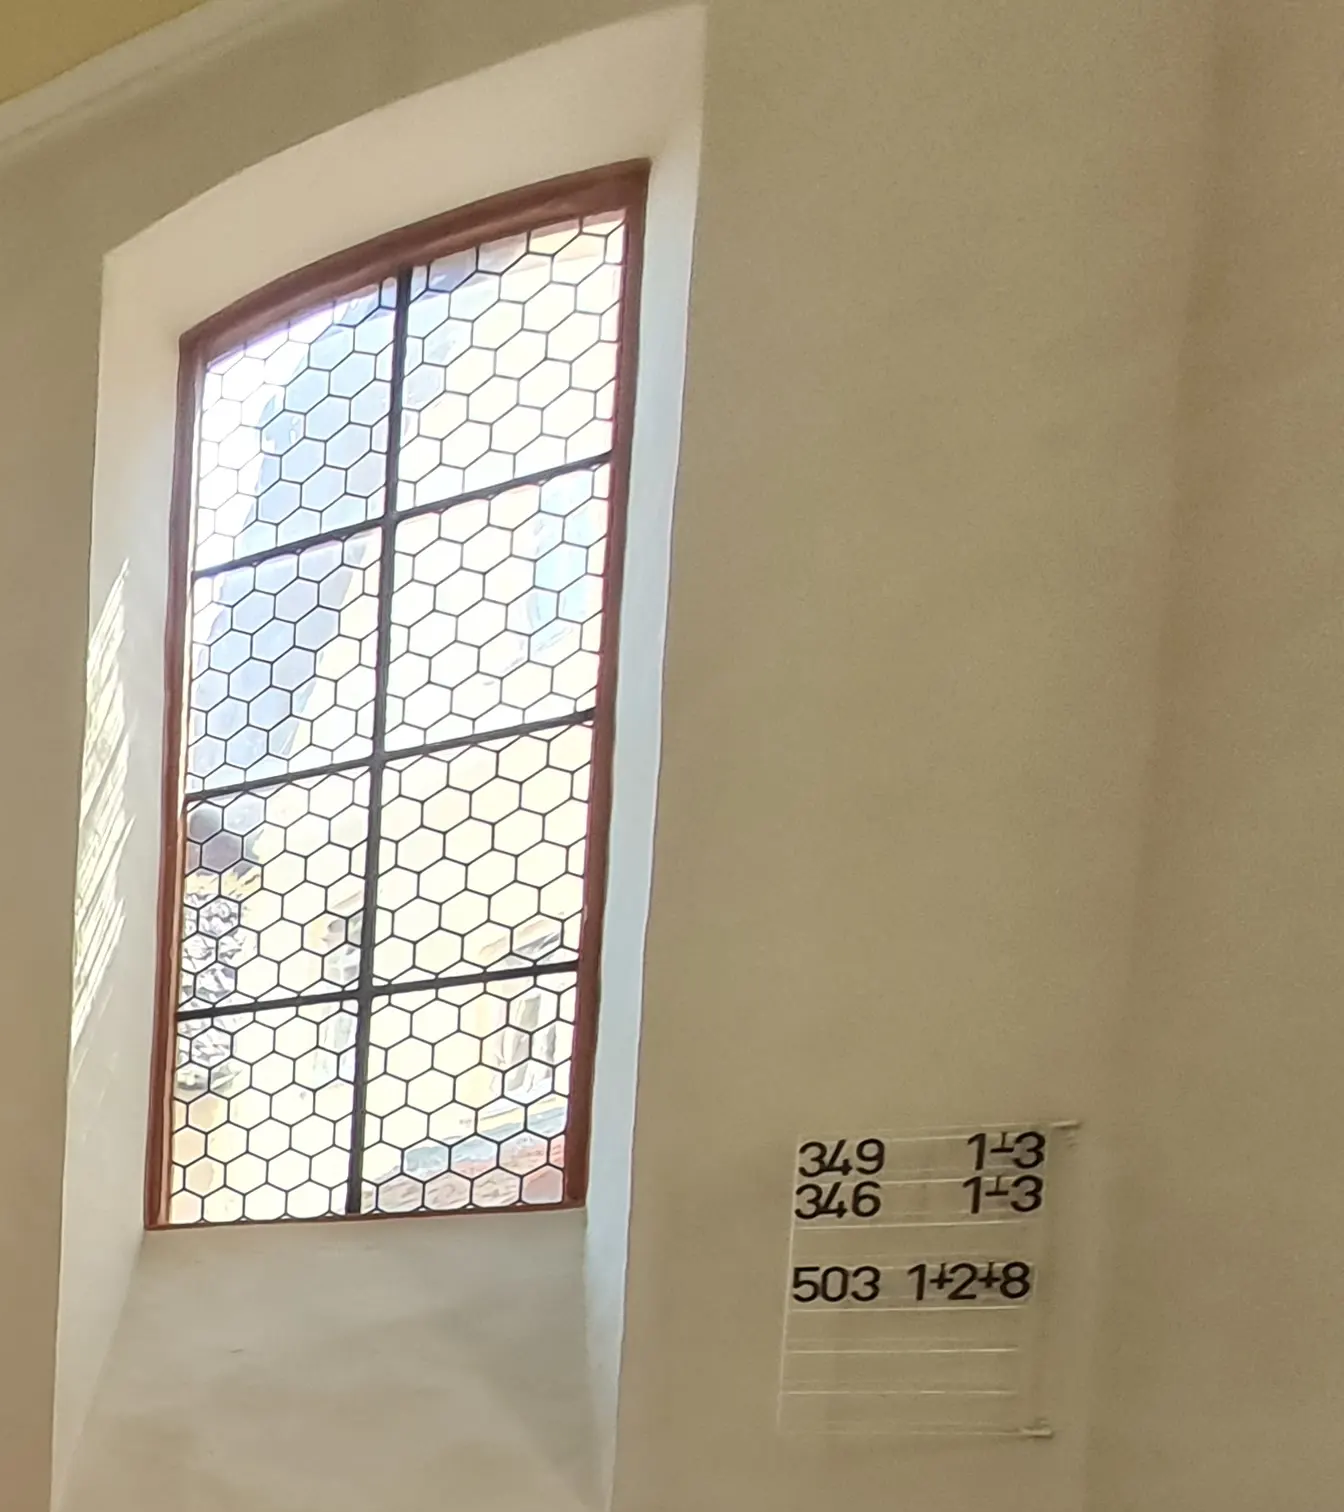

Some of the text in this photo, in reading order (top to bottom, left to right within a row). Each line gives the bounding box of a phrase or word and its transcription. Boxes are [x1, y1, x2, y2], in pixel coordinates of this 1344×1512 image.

[798, 1138, 886, 1177] 349
[794, 1181, 882, 1219] 346
[792, 1261, 1031, 1302] 503 1+2+8
